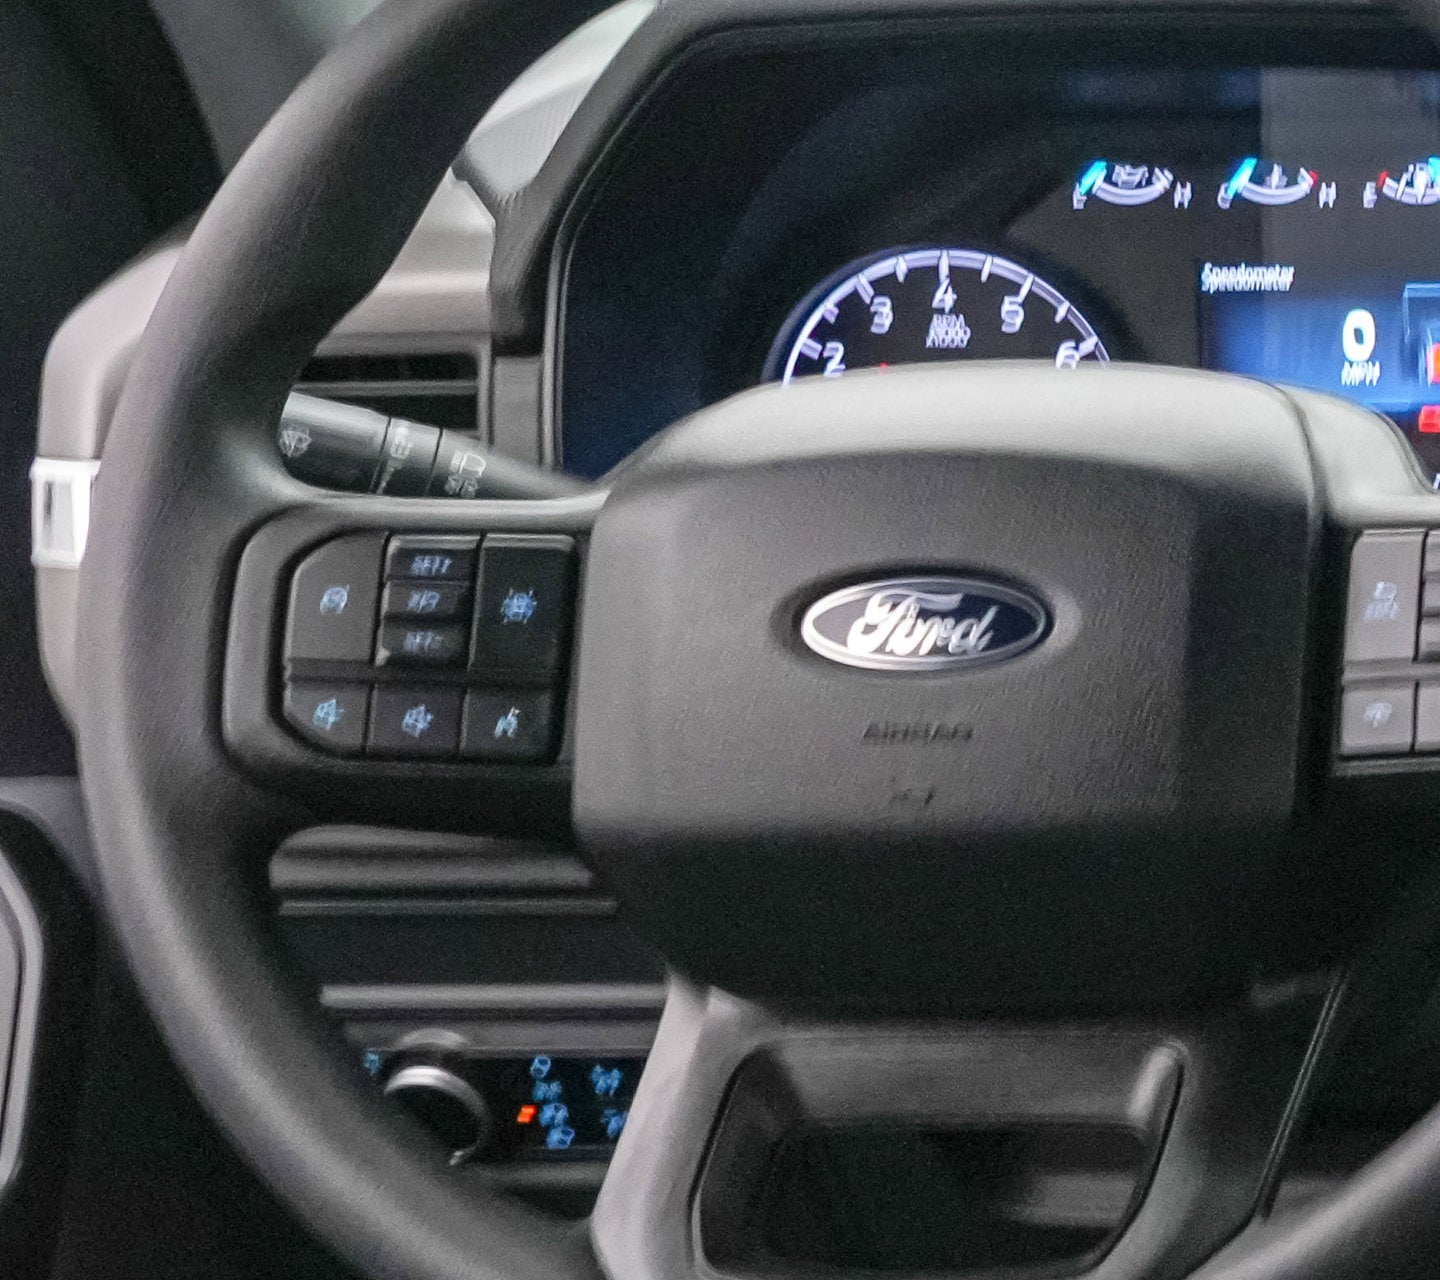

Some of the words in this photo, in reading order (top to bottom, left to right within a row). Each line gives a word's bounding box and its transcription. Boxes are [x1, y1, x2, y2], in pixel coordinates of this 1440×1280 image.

[931, 278, 957, 314] 4
[1201, 263, 1295, 294] Speedometer
[870, 296, 893, 334] 3
[1001, 294, 1025, 334] 5
[1342, 308, 1376, 361] 0
[823, 341, 846, 379] 2
[847, 587, 999, 656] Ford
